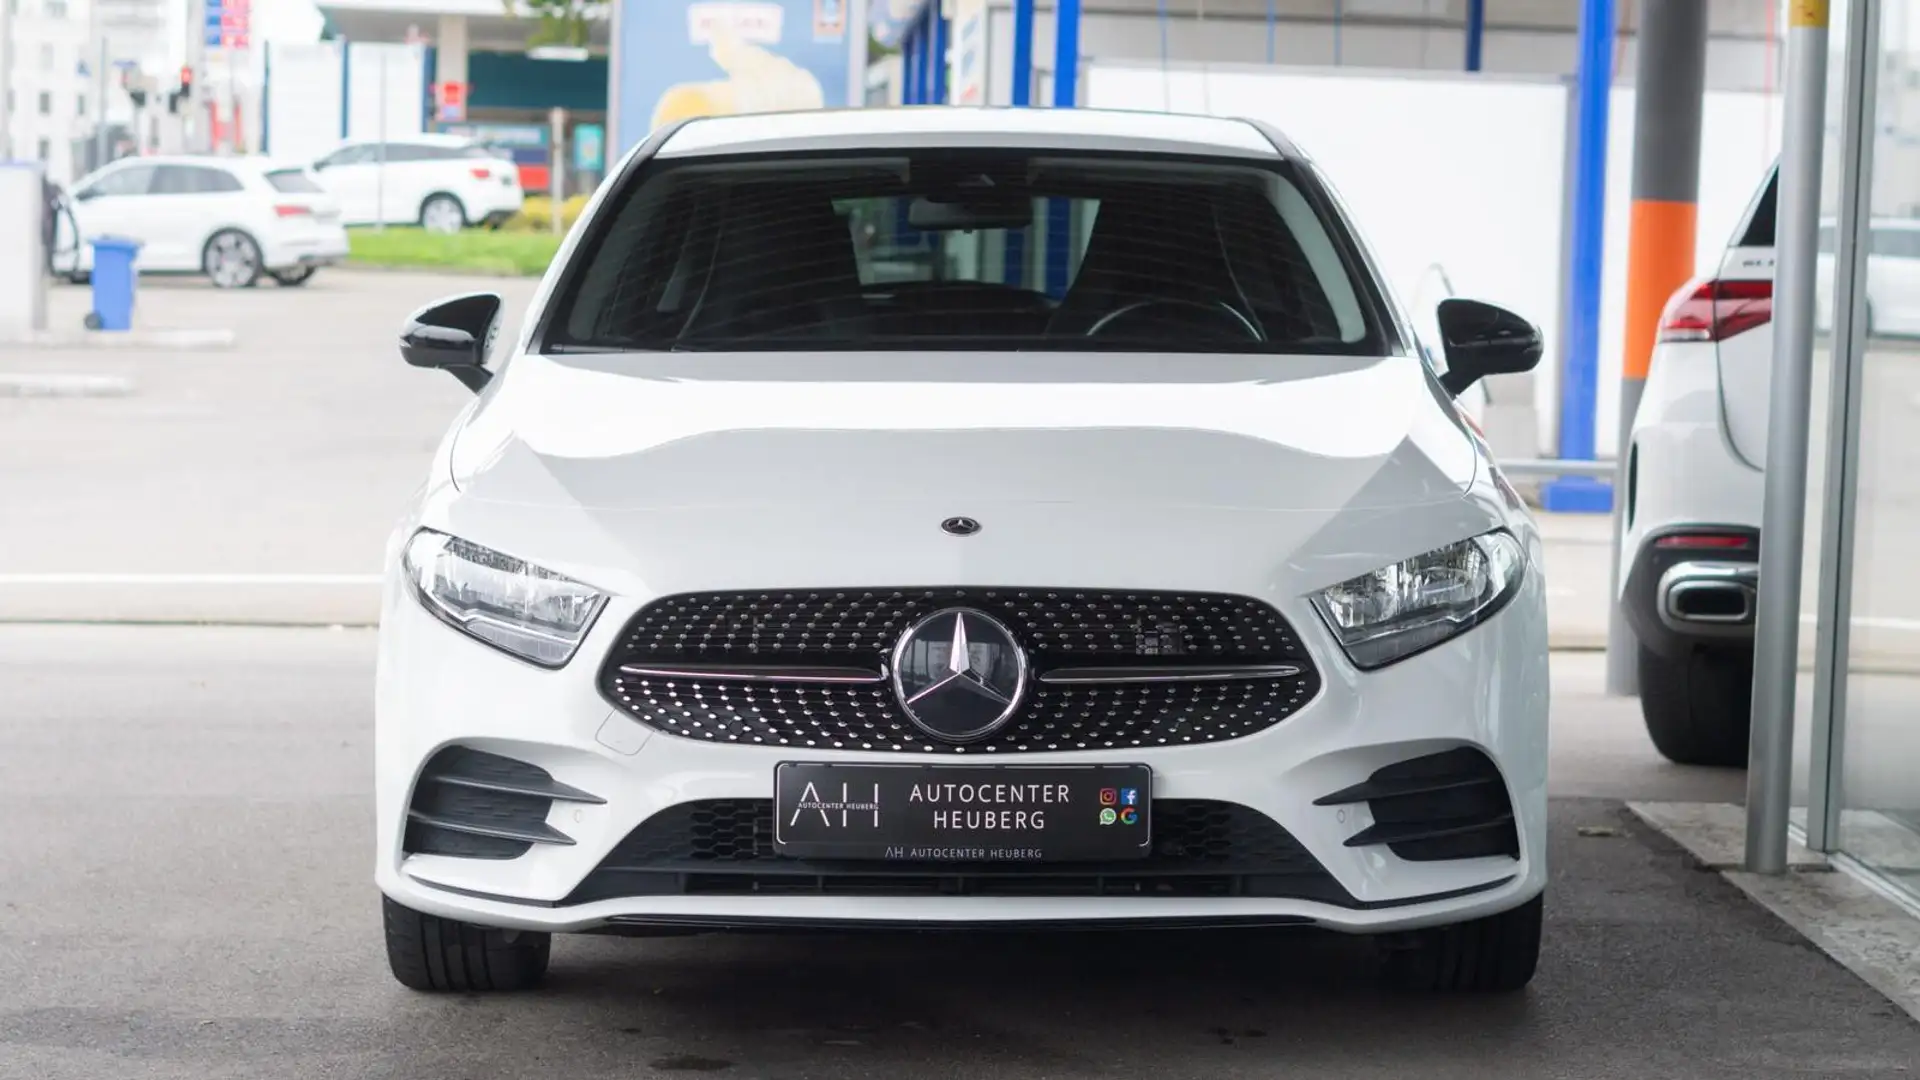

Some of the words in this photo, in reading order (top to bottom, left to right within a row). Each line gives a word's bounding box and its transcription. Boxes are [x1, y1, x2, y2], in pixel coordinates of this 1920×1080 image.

[909, 784, 1069, 803] AUTOCENTER
[790, 781, 878, 828] AH
[934, 810, 1045, 829] HEUBERG
[884, 846, 903, 858] AH
[910, 848, 985, 858] AUTOCENTER
[990, 848, 1042, 859] HEUBERG
